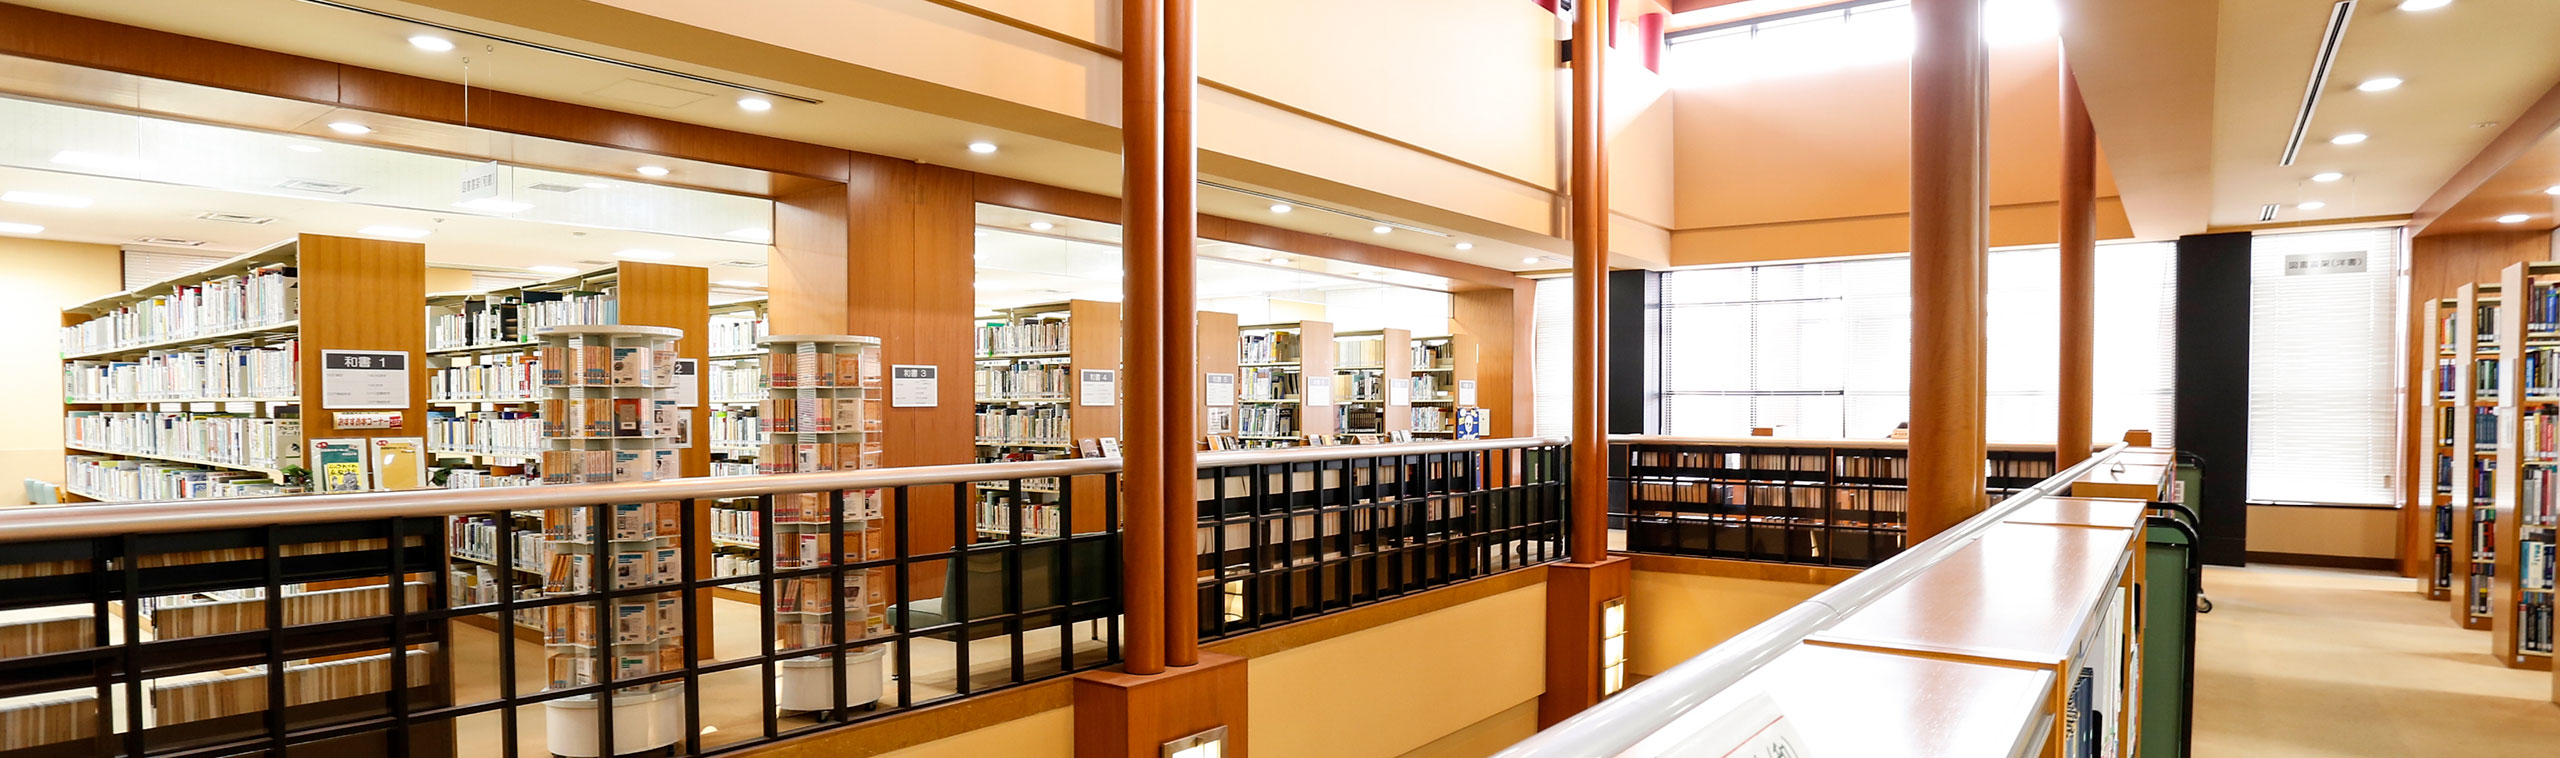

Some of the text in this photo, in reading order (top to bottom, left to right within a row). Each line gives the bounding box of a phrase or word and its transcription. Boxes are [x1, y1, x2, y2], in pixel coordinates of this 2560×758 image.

[344, 356, 385, 368] 和書 1
[675, 364, 683, 373] 2
[904, 369, 927, 377] 和書 3
